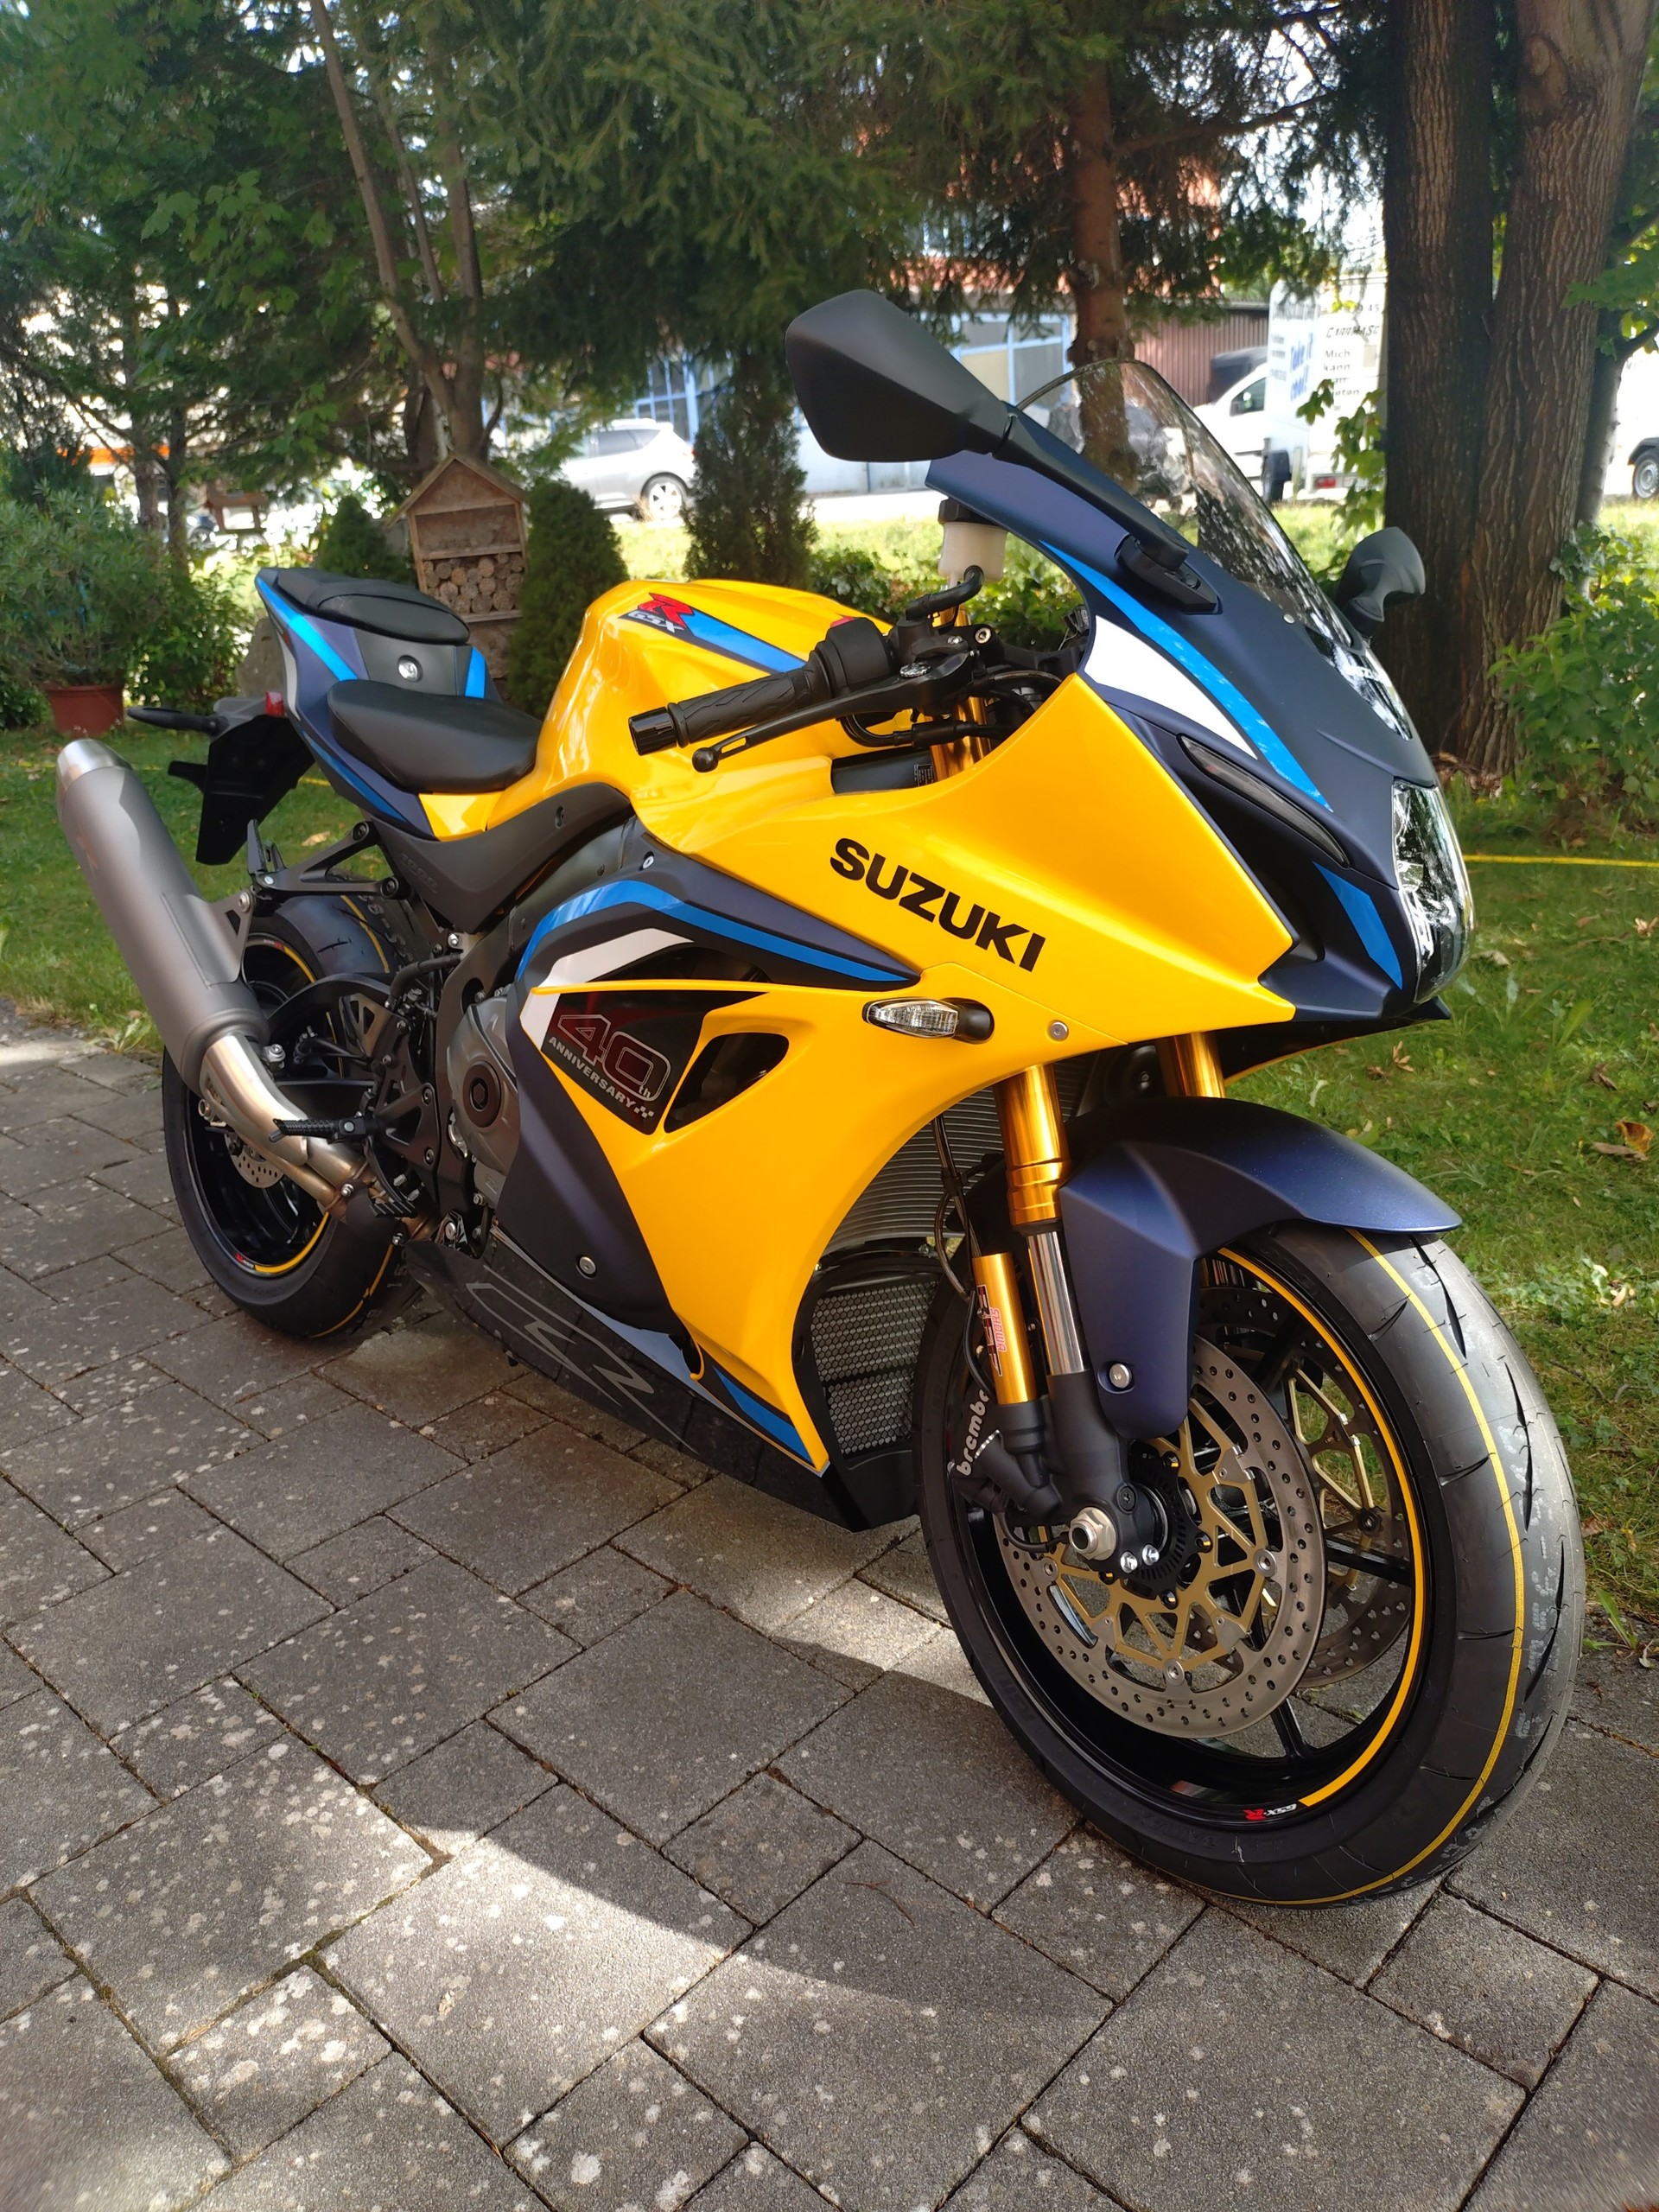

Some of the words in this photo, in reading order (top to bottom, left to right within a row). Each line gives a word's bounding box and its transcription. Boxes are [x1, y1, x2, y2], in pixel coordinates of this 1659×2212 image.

[830, 838, 1046, 972] SUZUKI
[548, 1036, 636, 1109] ANNIVERSARY
[991, 1306, 1007, 1352] SHOWA
